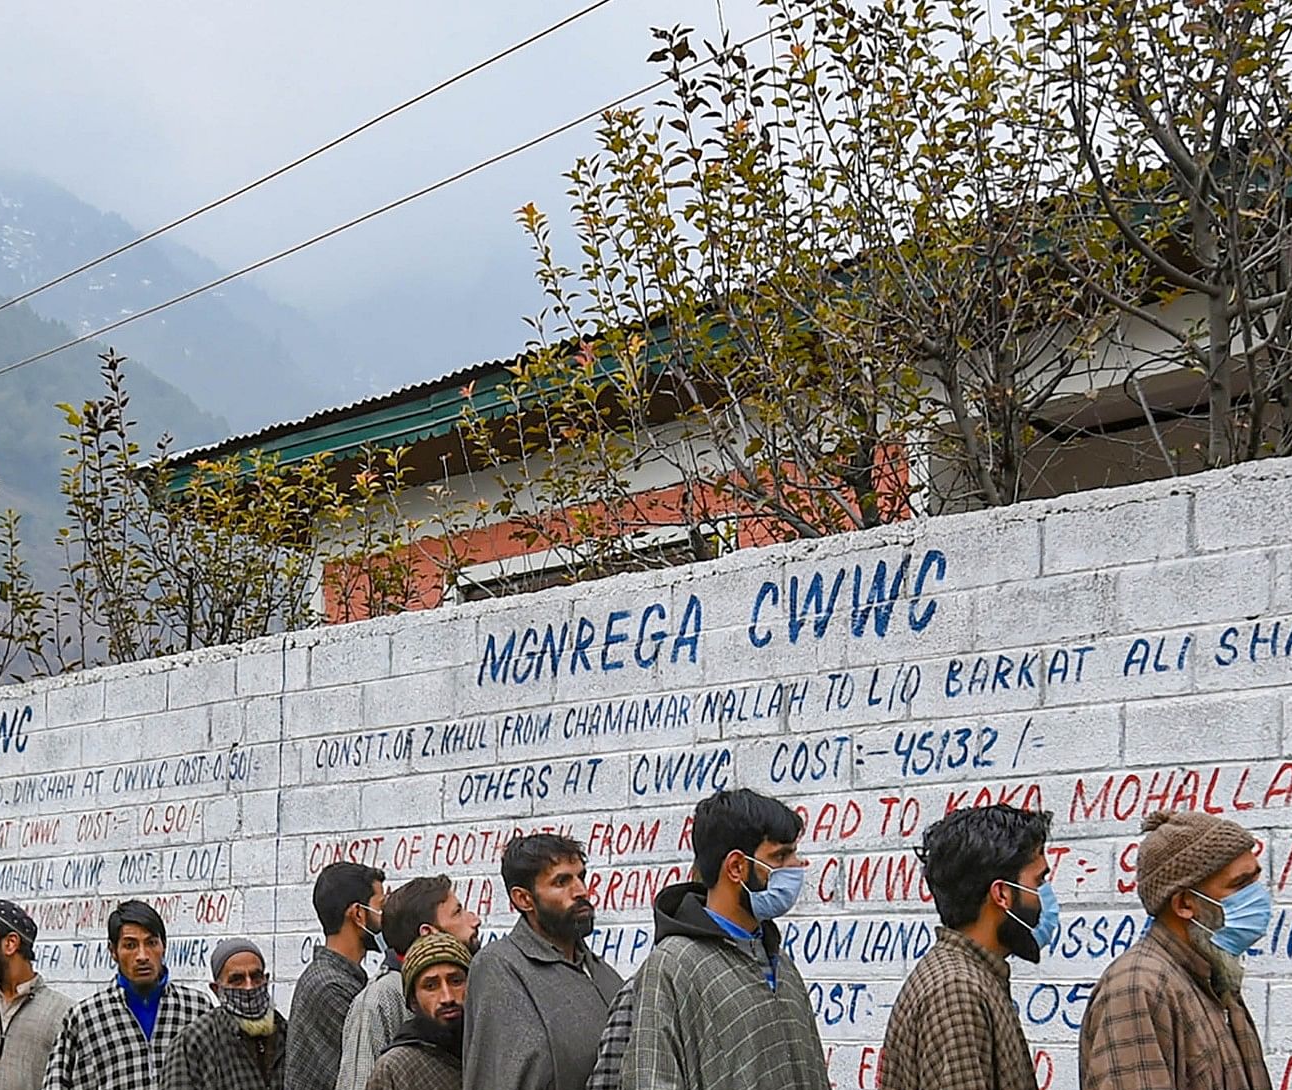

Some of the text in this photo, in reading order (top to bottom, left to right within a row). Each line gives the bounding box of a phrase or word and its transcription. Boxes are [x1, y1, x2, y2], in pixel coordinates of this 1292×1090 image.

[477, 550, 947, 687] MGNREGA CWWC
[501, 713, 552, 748] FROM
[564, 694, 690, 740] CHAMAMAR
[702, 680, 808, 724] NALLAH
[827, 673, 854, 712] TO
[945, 646, 1095, 698] BARKAT
[1123, 634, 1193, 677] ALI
[82, 770, 104, 797] AT
[113, 760, 168, 794] CWWC
[459, 763, 552, 806] OTHERS
[563, 758, 604, 795] AT
[632, 748, 733, 796] CWWC
[22, 818, 61, 849] CWWC
[795, 800, 863, 844] OAD
[879, 797, 921, 838] TO
[394, 834, 422, 871] OF
[588, 818, 660, 856] FROM
[63, 856, 105, 889] CWWC
[587, 866, 694, 911] BRAN
[73, 942, 88, 970] TO
